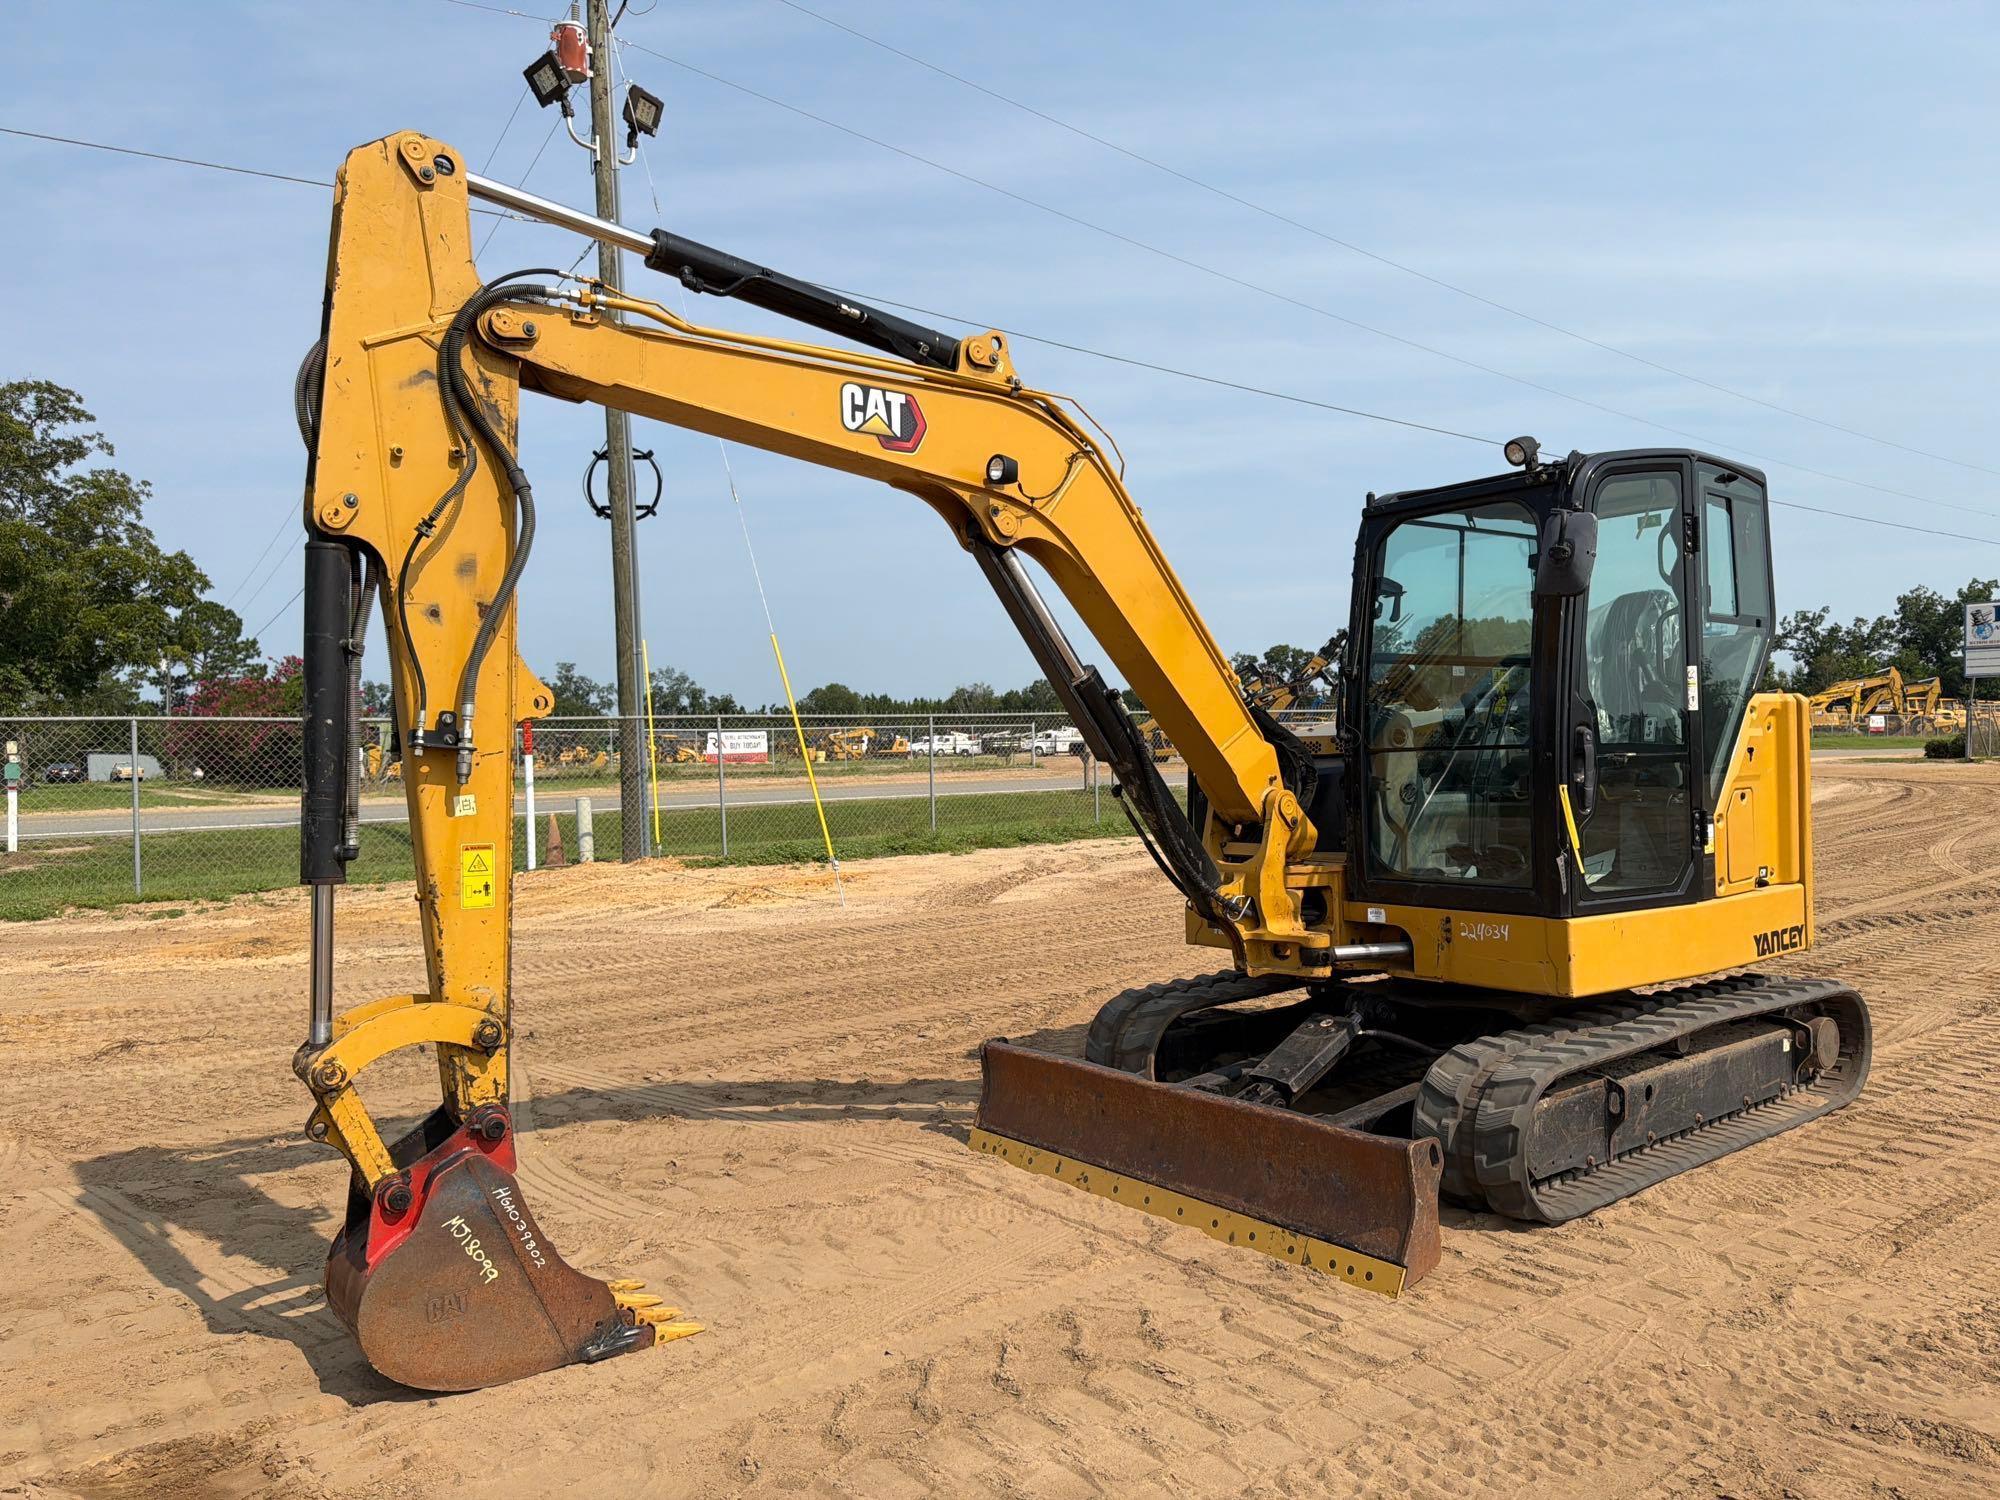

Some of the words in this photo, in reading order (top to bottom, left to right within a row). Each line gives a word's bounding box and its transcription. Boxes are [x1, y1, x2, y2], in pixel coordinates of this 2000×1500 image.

[842, 383, 906, 438] CAT
[1460, 922, 1509, 941] 224034
[1753, 924, 1805, 957] YANCEY
[441, 1215, 499, 1284] MJ18099
[425, 1289, 470, 1324] CAT
